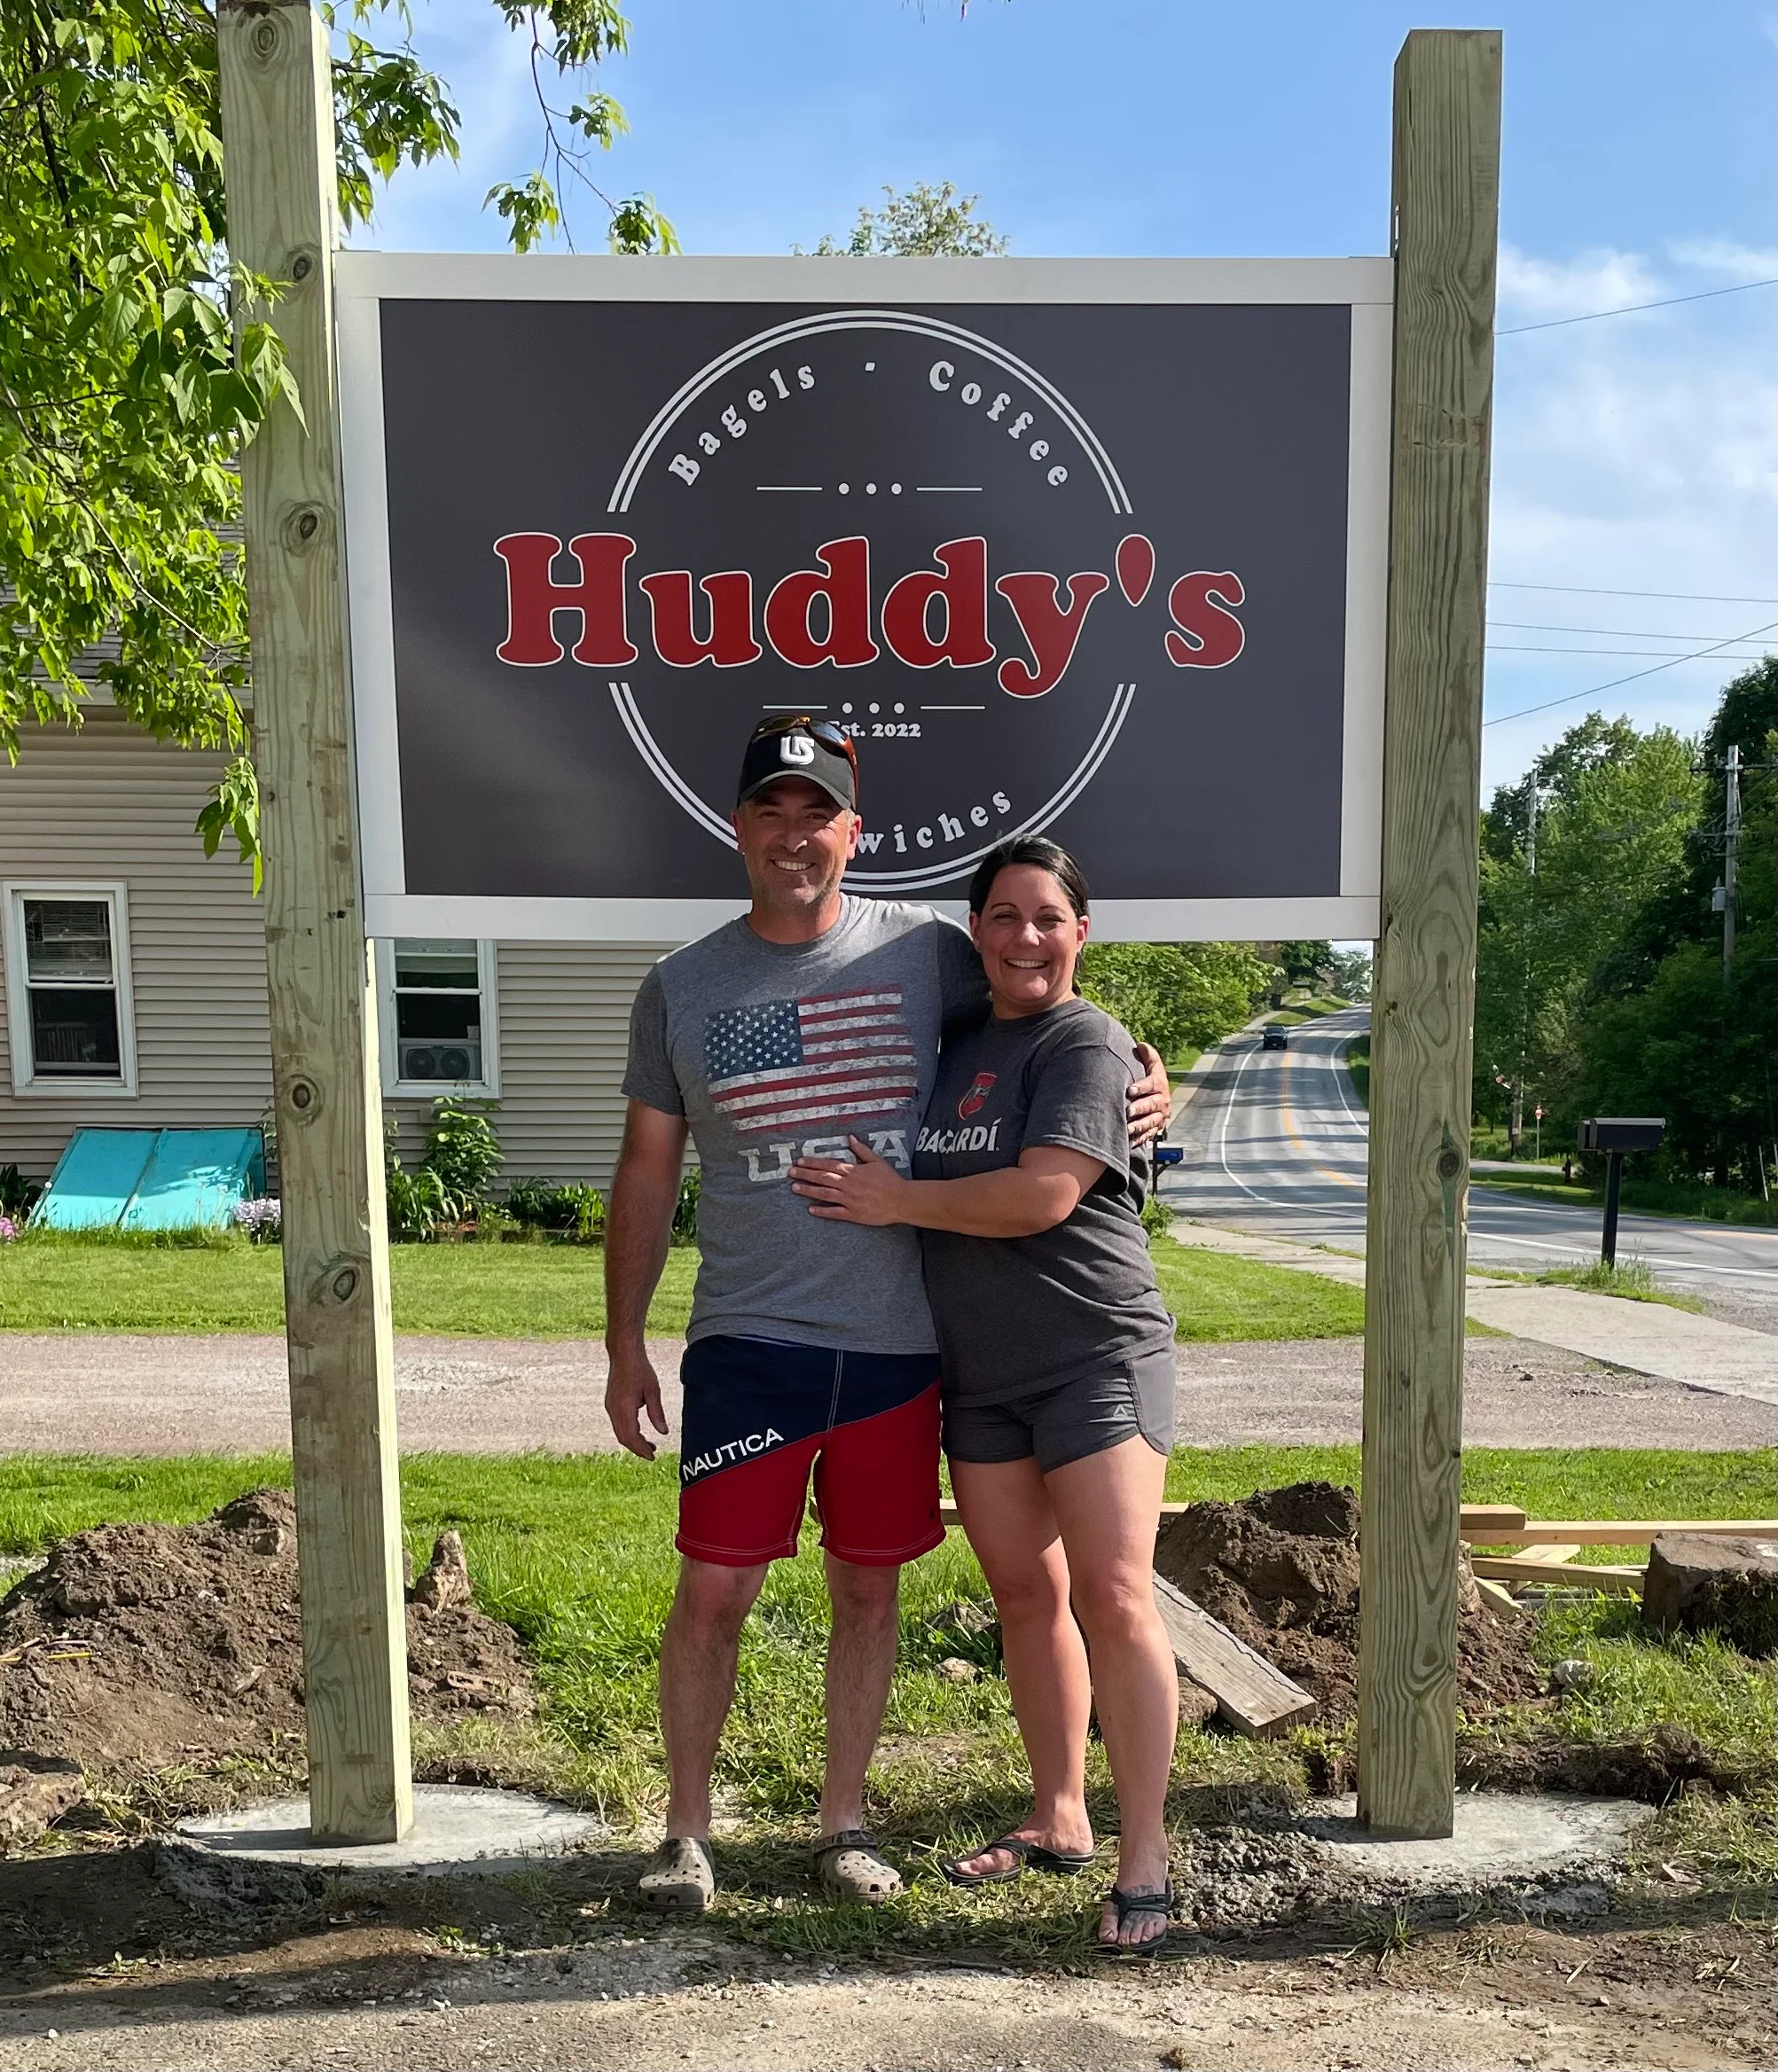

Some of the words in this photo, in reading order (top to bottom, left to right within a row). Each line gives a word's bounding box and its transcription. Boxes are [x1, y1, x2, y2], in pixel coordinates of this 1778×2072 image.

[668, 364, 815, 486] Bagels
[929, 360, 1069, 487] Coffee
[493, 531, 1246, 699] Huddy's
[828, 720, 866, 738] st.
[871, 723, 921, 738] 2022
[857, 791, 1012, 855] wiches
[682, 1427, 784, 1482] NAUTICA
